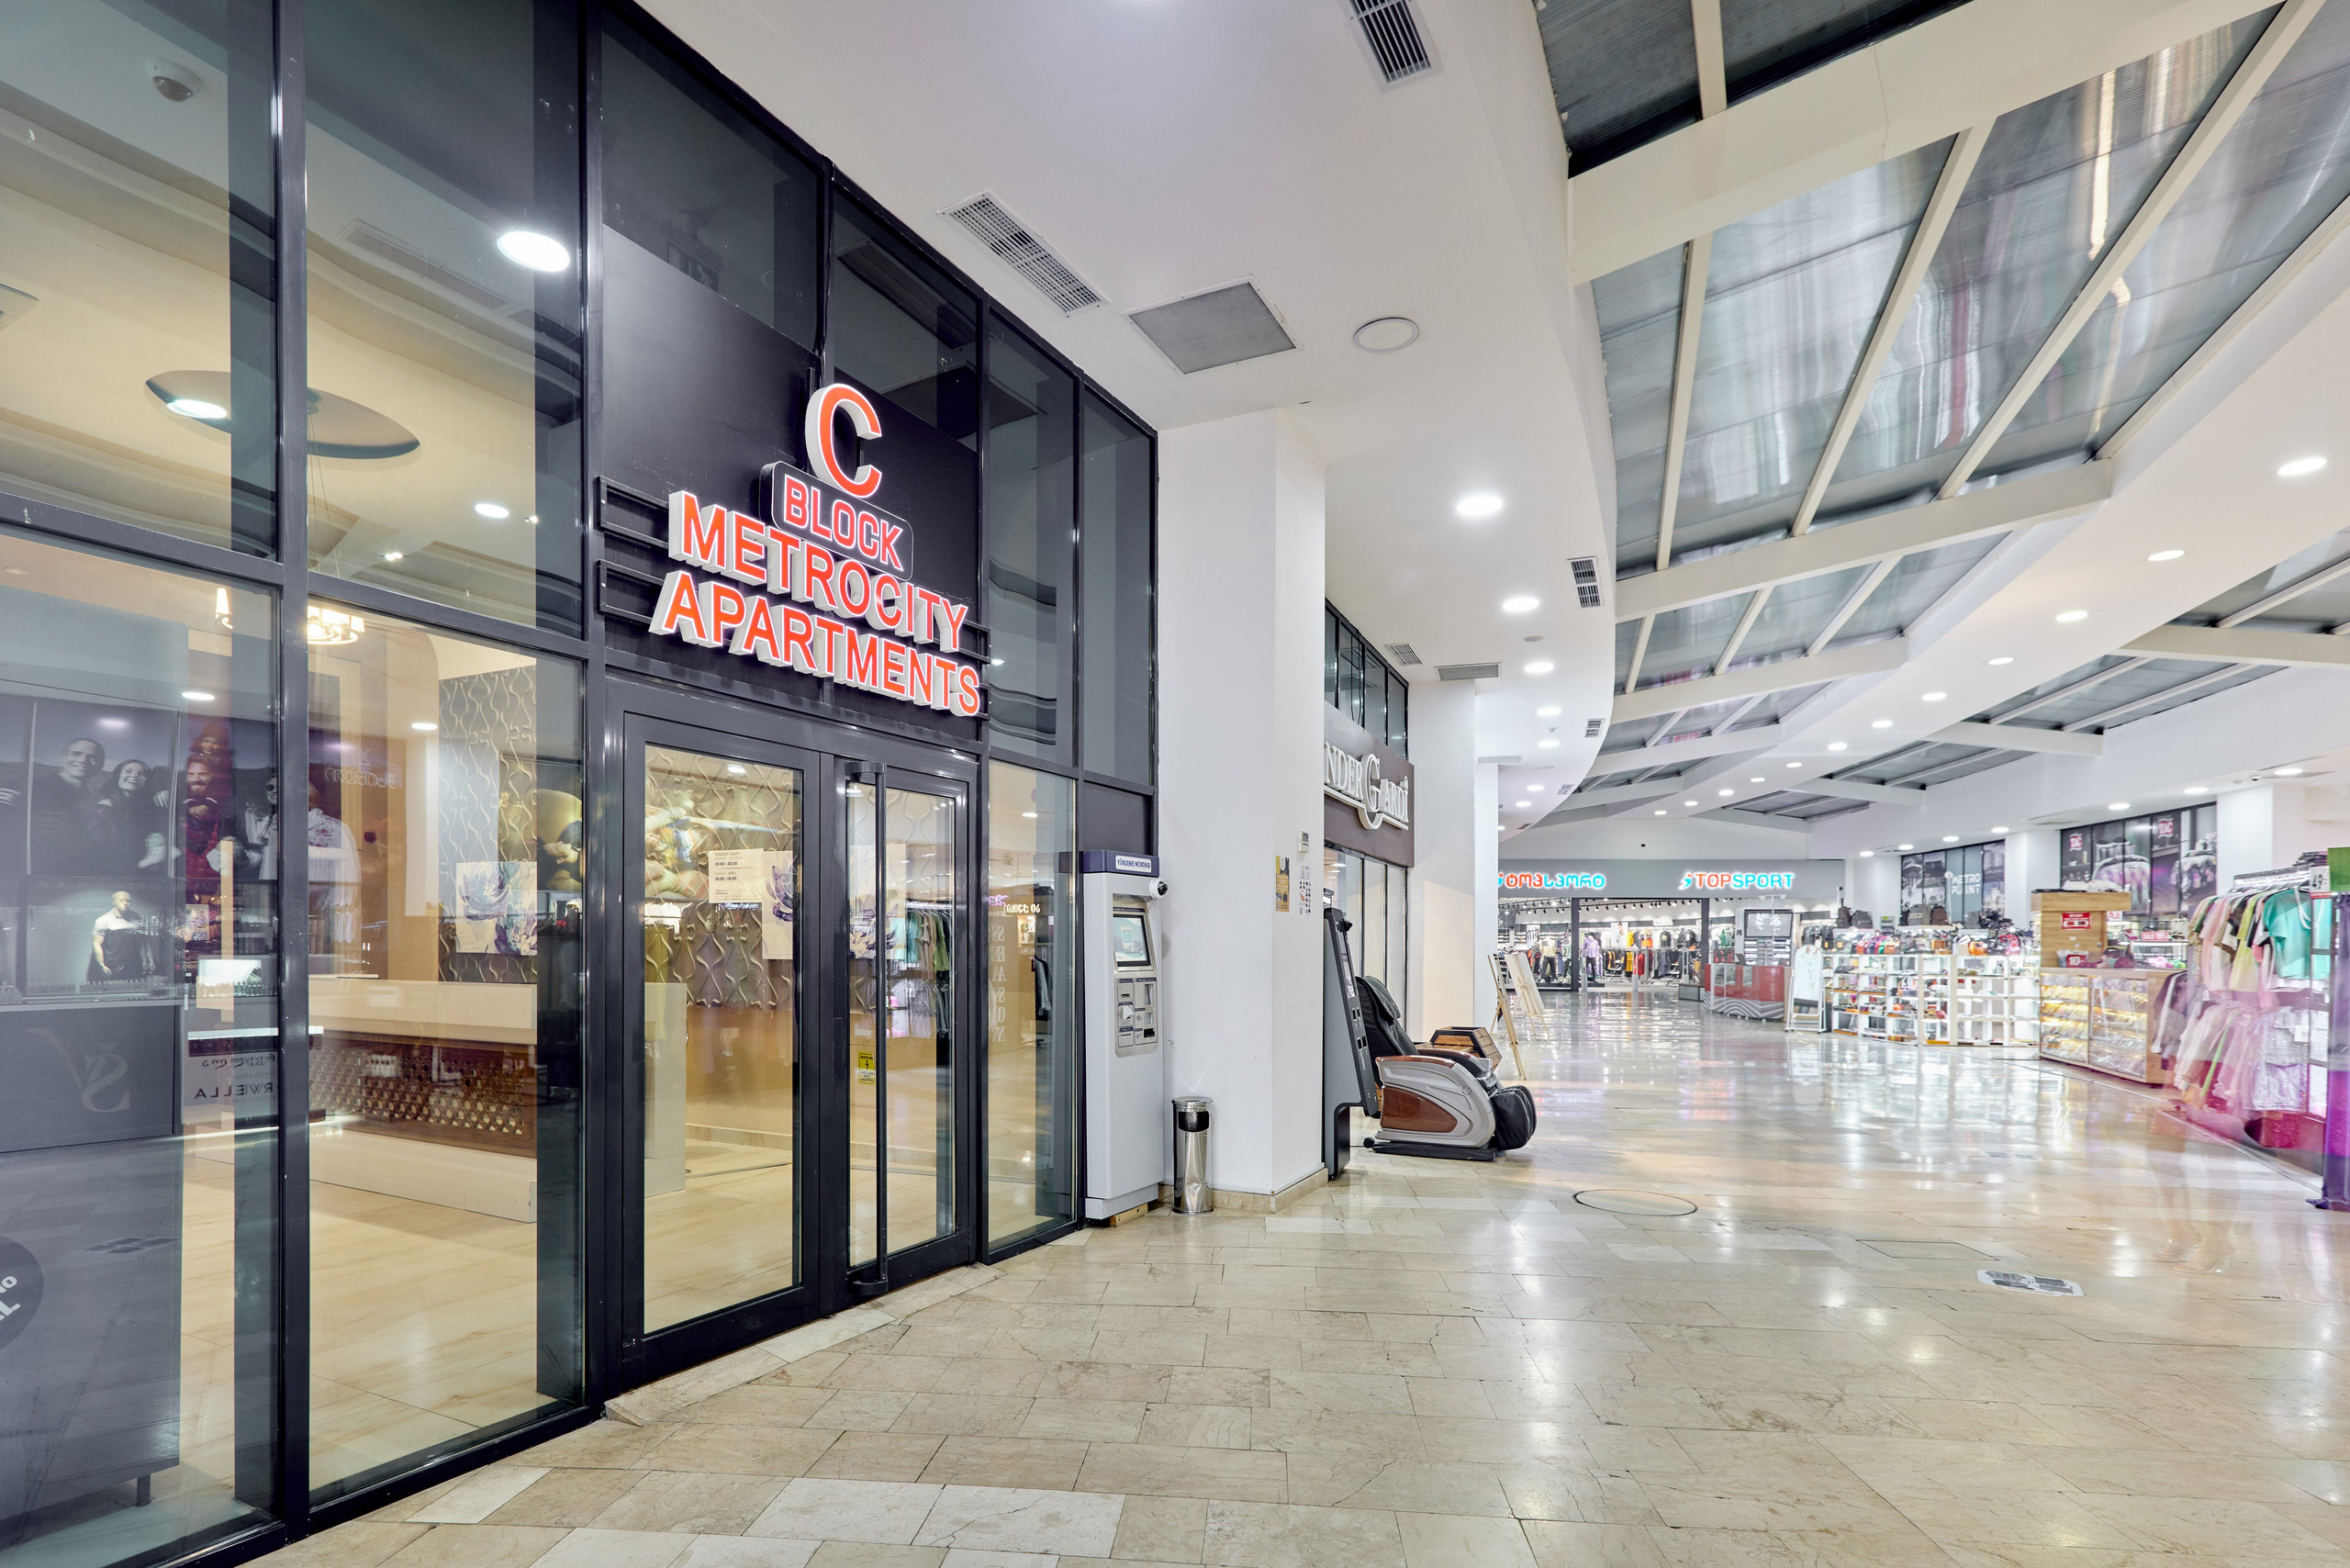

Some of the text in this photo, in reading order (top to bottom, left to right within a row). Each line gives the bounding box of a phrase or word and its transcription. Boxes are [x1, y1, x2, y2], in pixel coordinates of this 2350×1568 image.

[805, 383, 882, 498] C
[669, 489, 968, 653] METROCITY
[784, 474, 903, 572] BLOCK
[649, 569, 980, 716] APARTMENTS
[1695, 873, 1795, 888] TOPSPORT
[1952, 873, 1981, 884] METRO
[1952, 884, 1981, 895] POINT
